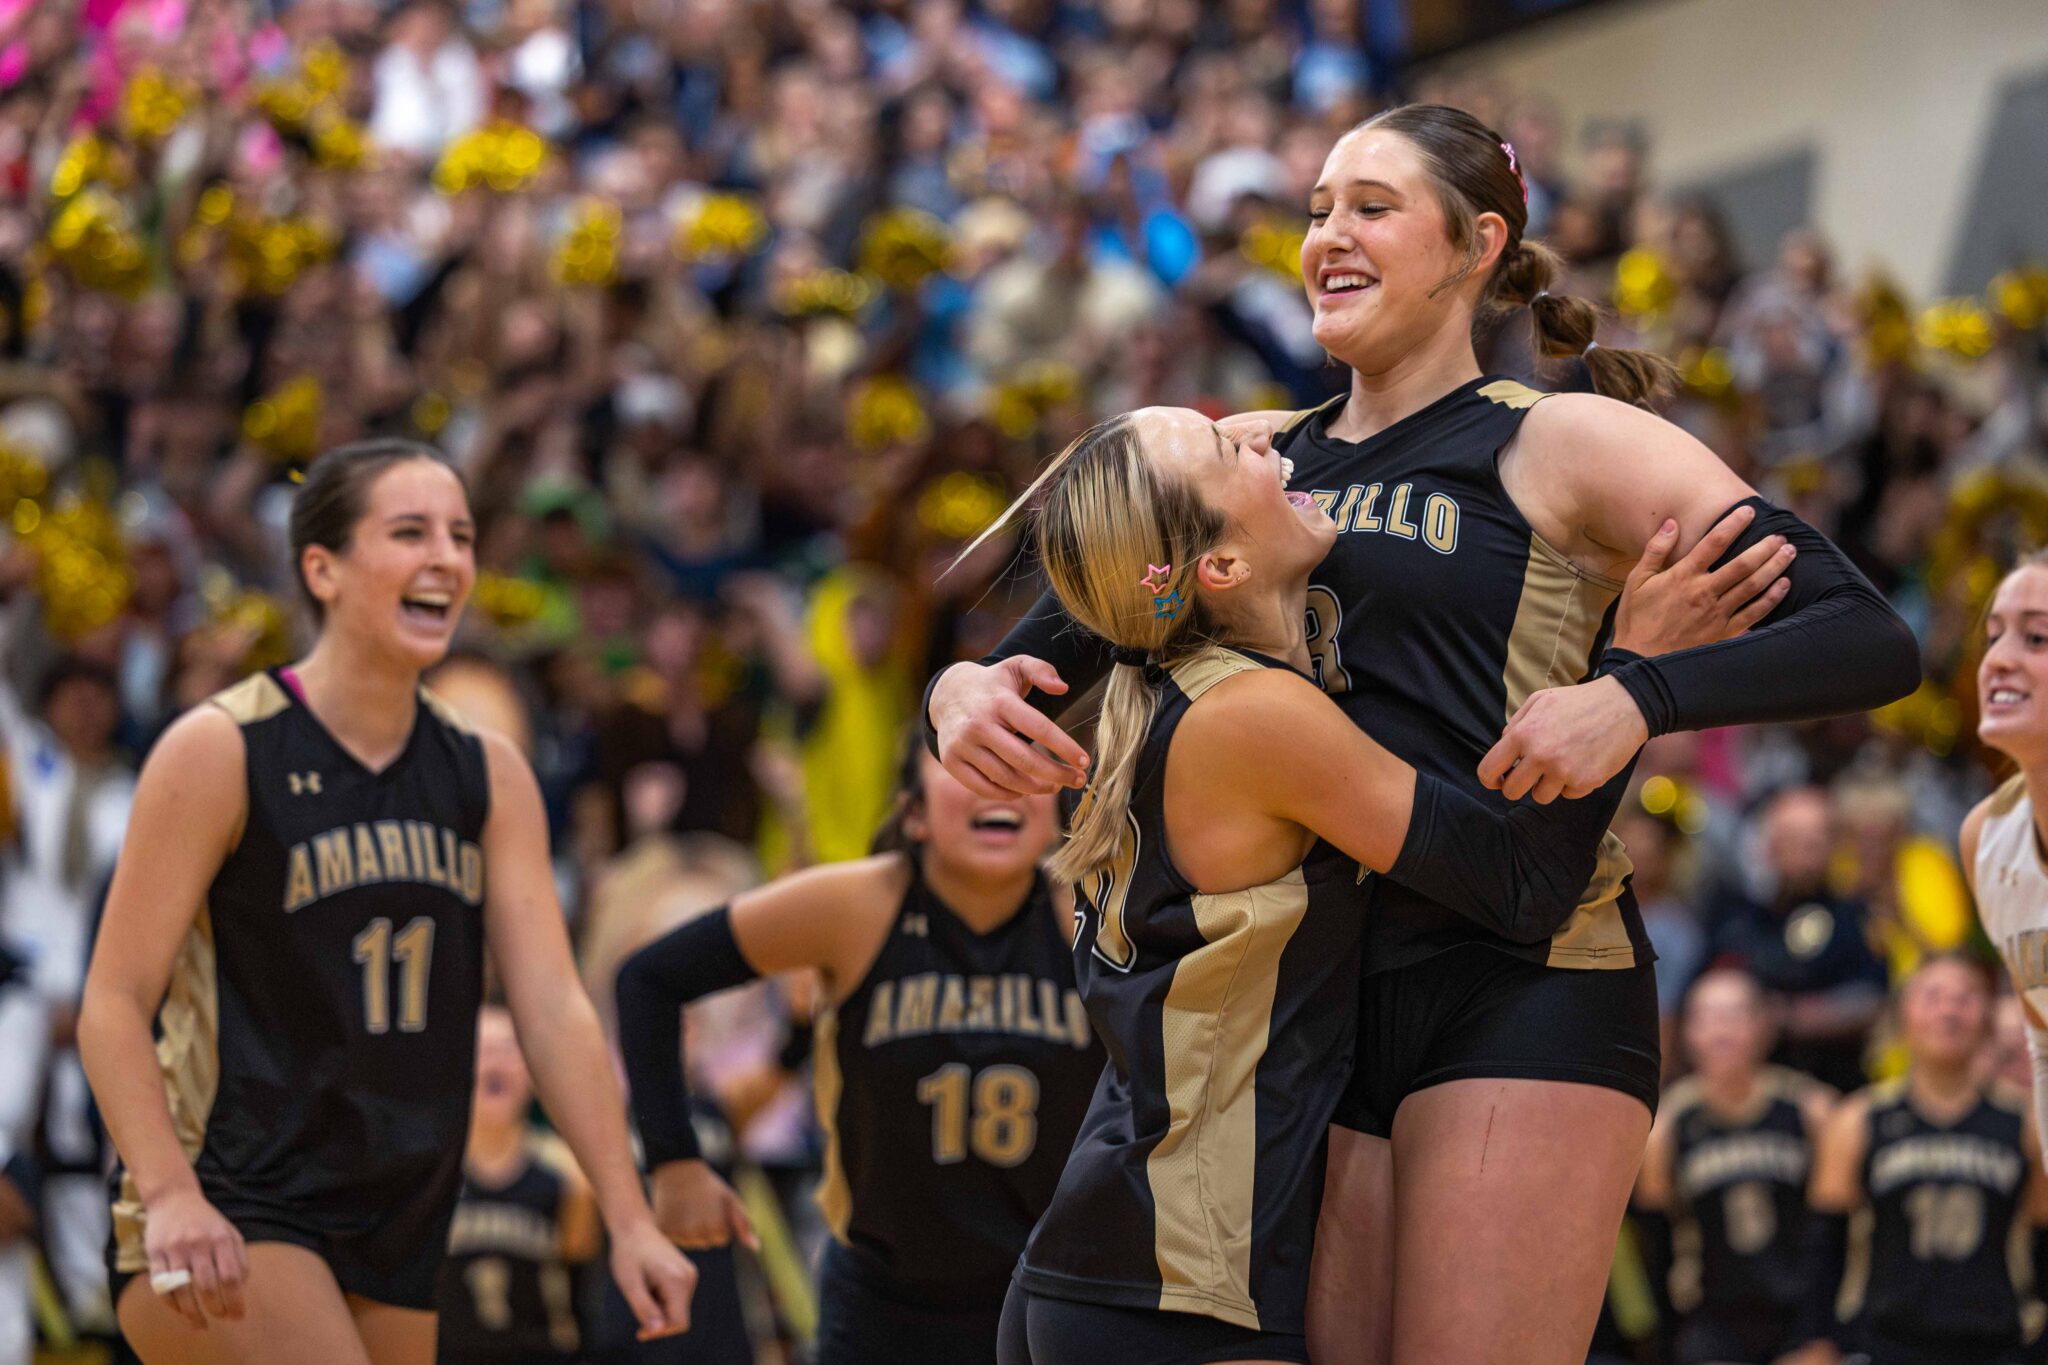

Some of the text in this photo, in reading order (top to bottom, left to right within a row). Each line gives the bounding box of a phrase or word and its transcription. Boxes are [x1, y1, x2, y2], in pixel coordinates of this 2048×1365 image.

[284, 819, 482, 913] AMARILLO
[352, 916, 436, 1034] 11
[916, 1062, 1041, 1168] 18
